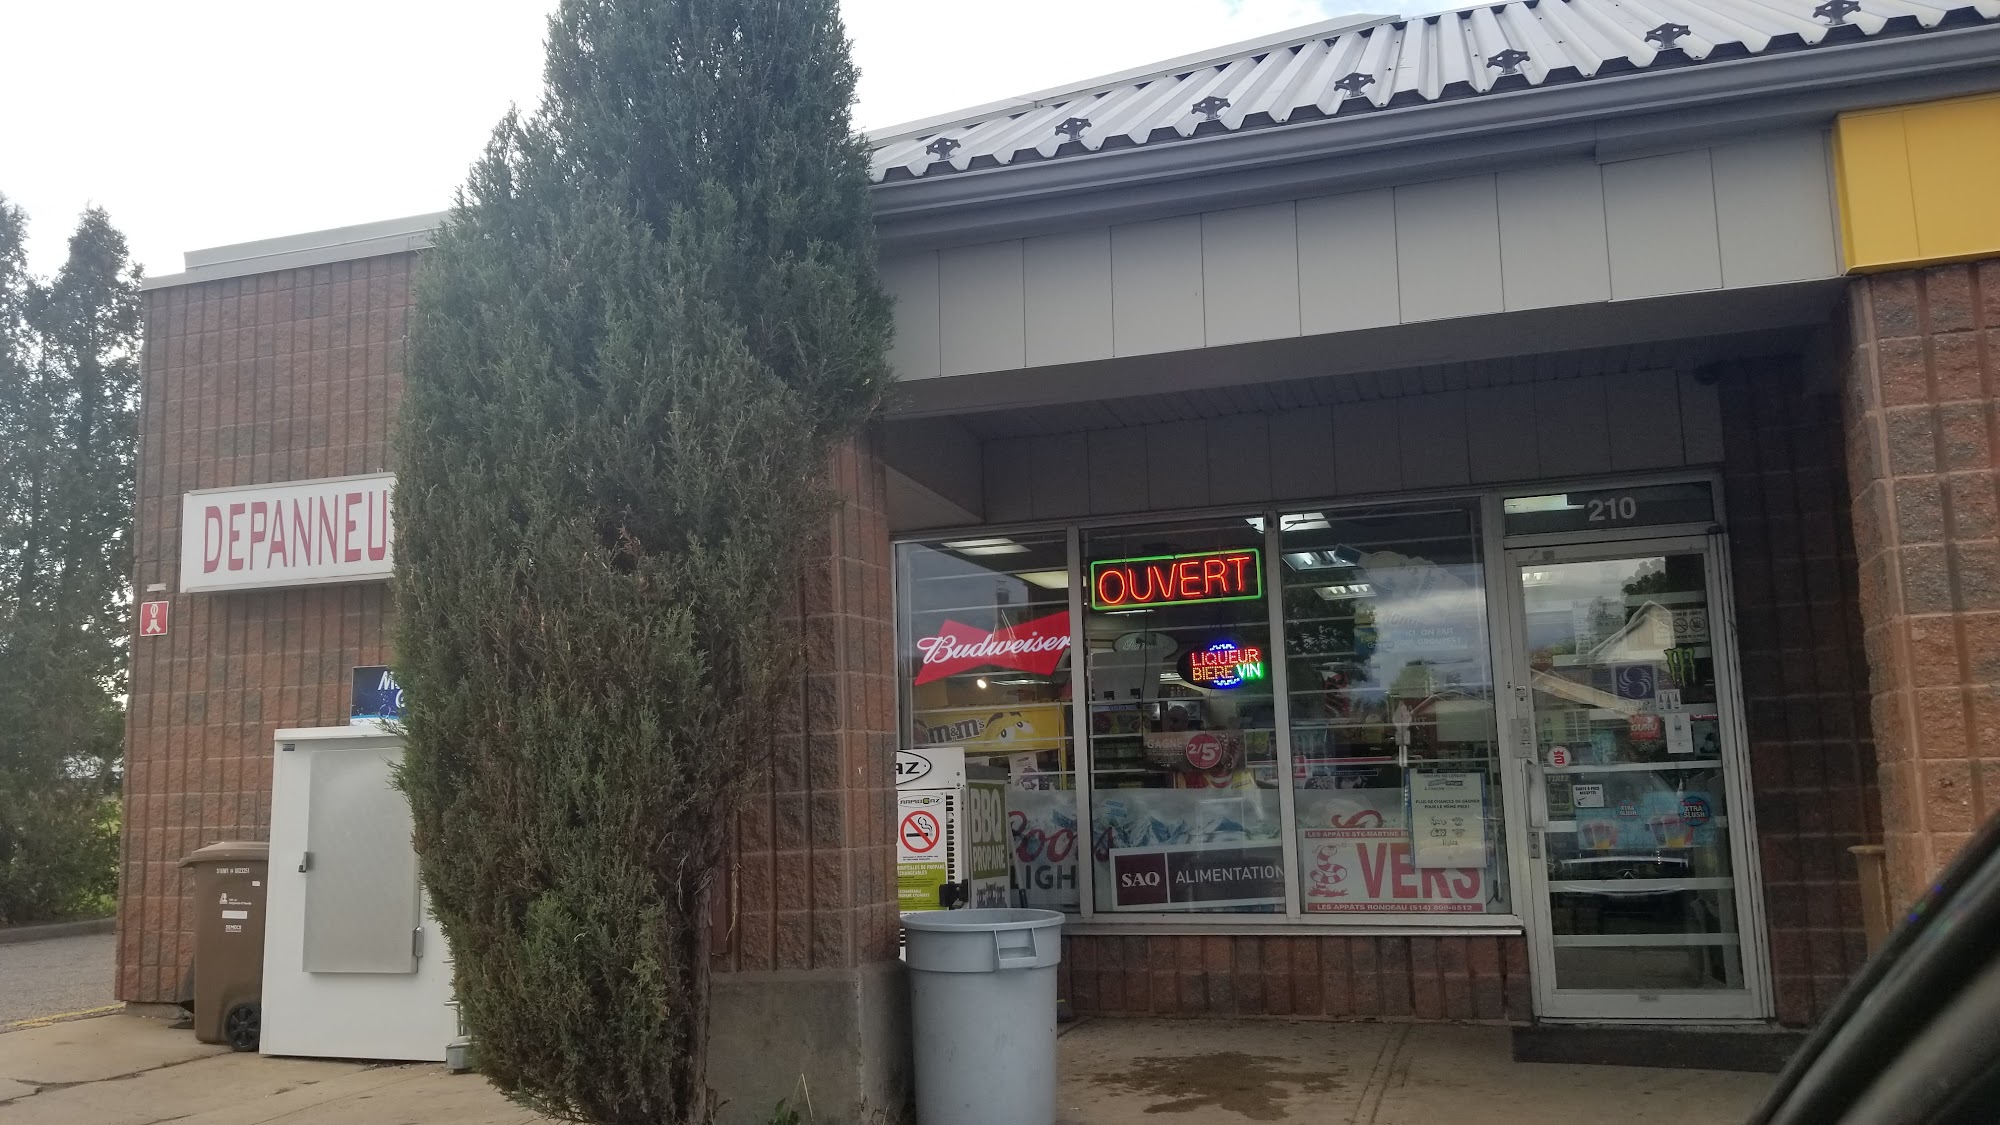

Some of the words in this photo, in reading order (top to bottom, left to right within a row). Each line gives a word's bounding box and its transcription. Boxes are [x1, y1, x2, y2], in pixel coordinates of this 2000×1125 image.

[1588, 496, 1636, 521] 210
[203, 489, 387, 573] DEPANNEU
[1099, 556, 1251, 604] OUVERT
[917, 630, 1071, 665] Budweiser
[1191, 649, 1259, 666] LIQUEUR
[1192, 666, 1235, 681] BIERE
[1236, 664, 1262, 679] VIN
[896, 762, 920, 774] AZ
[970, 788, 1003, 843] BBQ
[1683, 811, 1706, 819] SLUSH
[1684, 805, 1703, 813] XTRA
[973, 844, 1006, 872] PROPANE
[1356, 842, 1481, 899] VERS
[1009, 864, 1076, 890] LIGH
[1121, 872, 1160, 888] SAQ
[1175, 865, 1284, 885] ALIMENTATION
